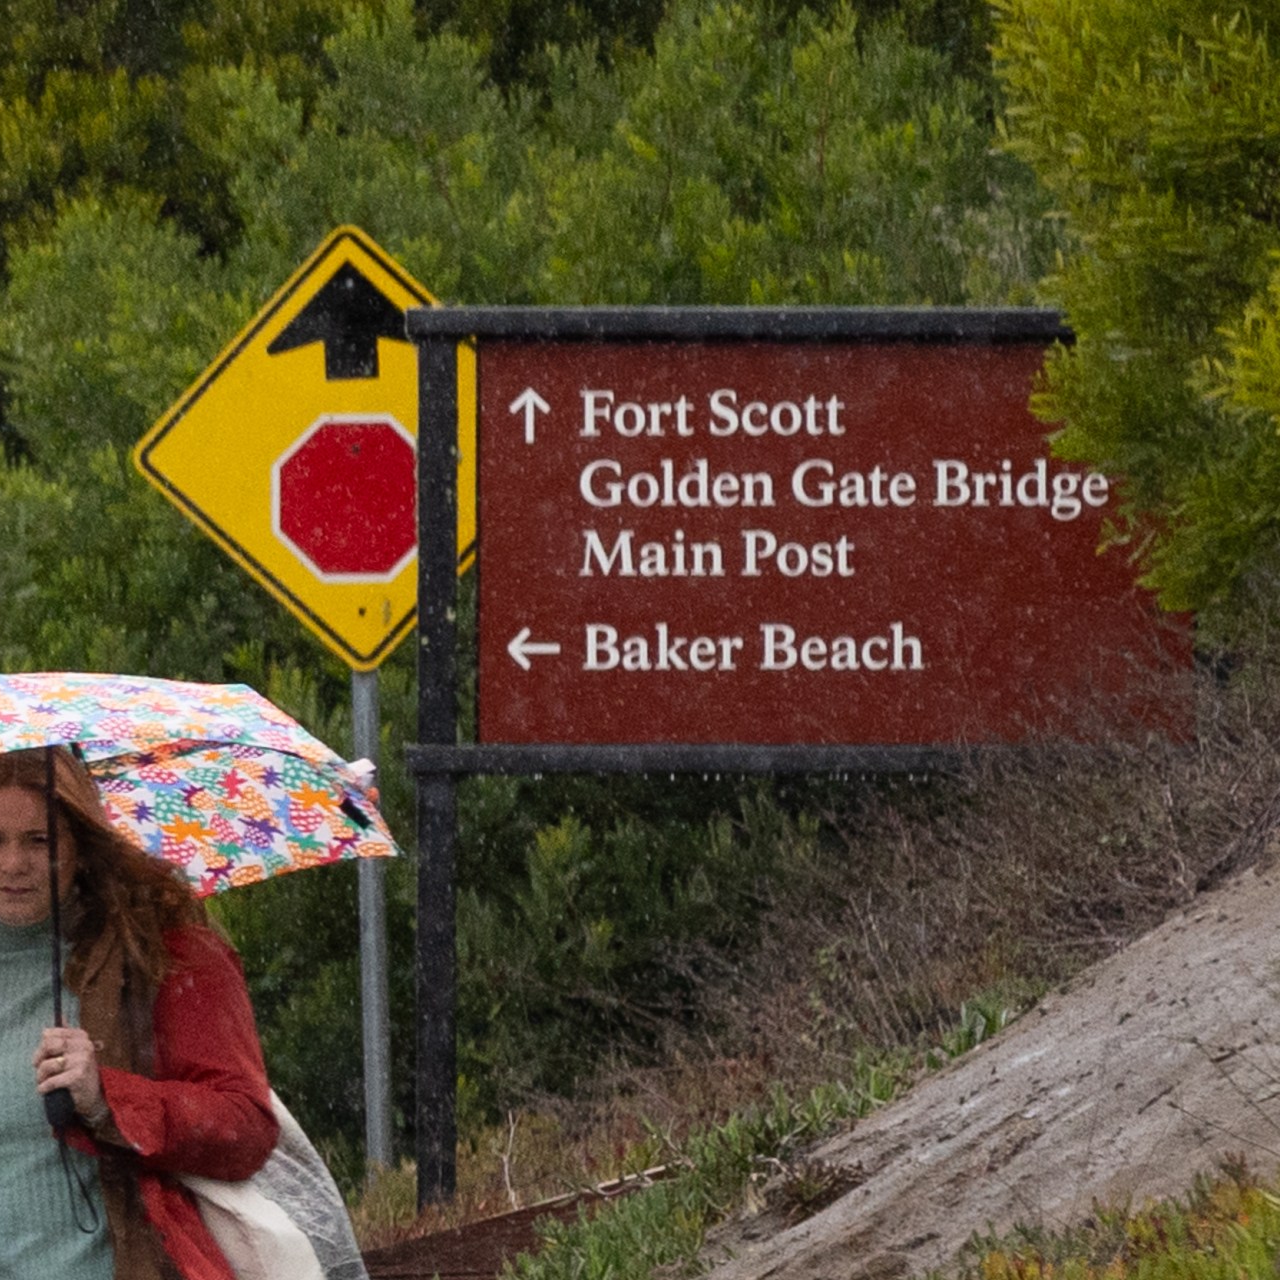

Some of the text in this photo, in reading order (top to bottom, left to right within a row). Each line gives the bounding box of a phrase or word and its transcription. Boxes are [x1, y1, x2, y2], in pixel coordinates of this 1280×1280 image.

[579, 389, 845, 437] Fort Scott
[579, 459, 1109, 521] Golden Gate Bridge
[579, 529, 855, 577] Main Post
[583, 622, 924, 671] Baker Beach
